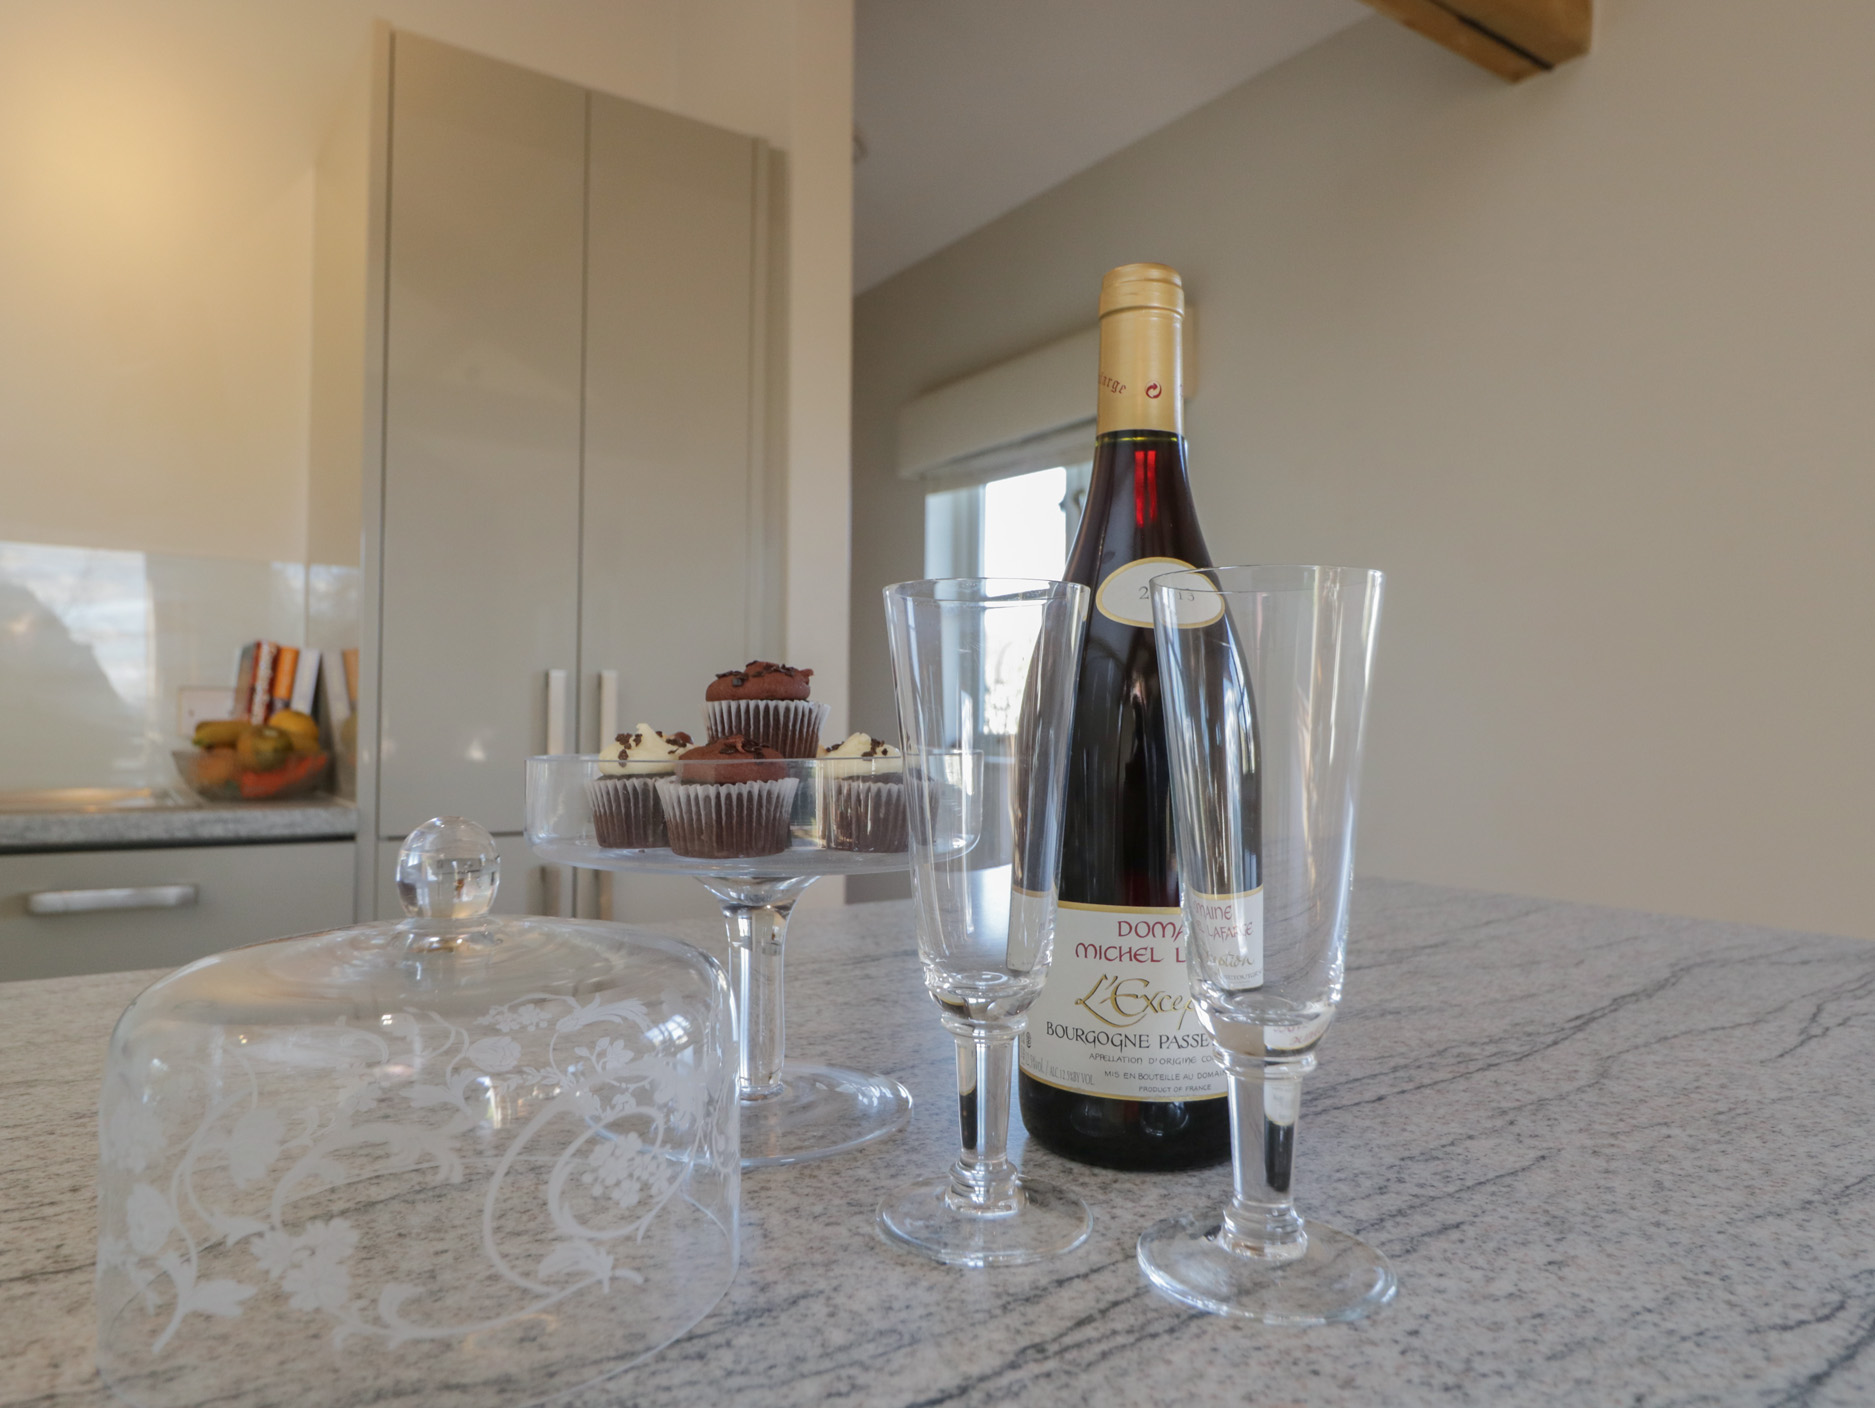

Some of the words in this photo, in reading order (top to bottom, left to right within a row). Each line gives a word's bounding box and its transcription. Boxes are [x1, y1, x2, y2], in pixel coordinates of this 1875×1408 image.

[1099, 373, 1127, 394] arge
[1075, 942, 1165, 963] MICHEL
[1046, 1021, 1151, 1052] BOURGOGNE
[1104, 1070, 1120, 1079] MIS
[1183, 1073, 1194, 1081] AU
[1138, 1085, 1171, 1094] PRODUCT
[1185, 1084, 1212, 1092] FRANCE
